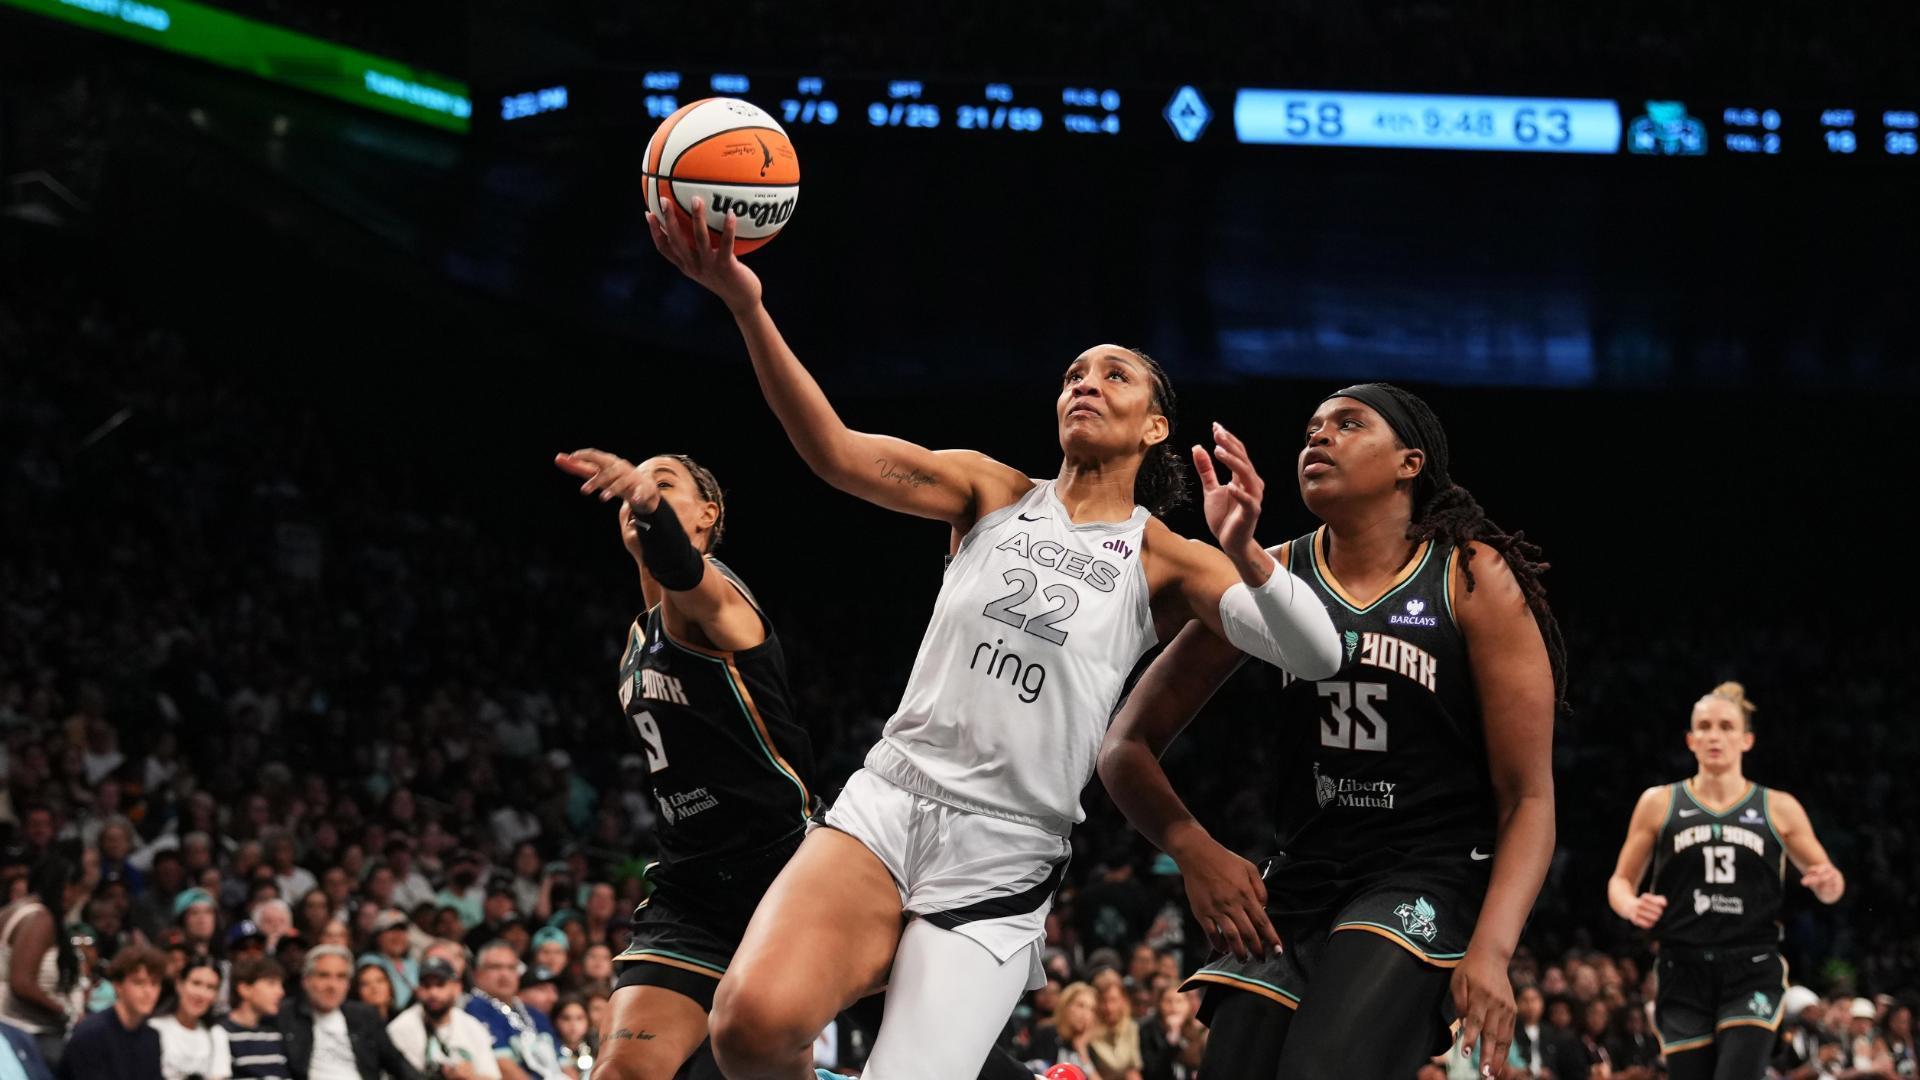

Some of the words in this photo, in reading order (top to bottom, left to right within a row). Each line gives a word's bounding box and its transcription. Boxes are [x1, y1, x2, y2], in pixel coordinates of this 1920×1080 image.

[1284, 101, 1344, 138] 58
[1512, 107, 1573, 145] 63
[711, 192, 795, 228] Wilson
[996, 531, 1121, 593] ACES
[1102, 539, 1134, 560] ally
[983, 568, 1080, 647] 22
[1390, 615, 1437, 627] BARCLAYS
[970, 638, 1046, 704] ring
[1360, 631, 1438, 694] YORK
[1315, 681, 1388, 752] 35
[632, 710, 670, 774] 9
[669, 786, 709, 808] Liberty
[1337, 777, 1396, 798] Liberty
[1337, 794, 1394, 810] Mutual
[676, 794, 720, 821] Mutual
[1673, 824, 1712, 854] NEW
[1722, 824, 1765, 857] YORK
[1702, 846, 1736, 884] 13
